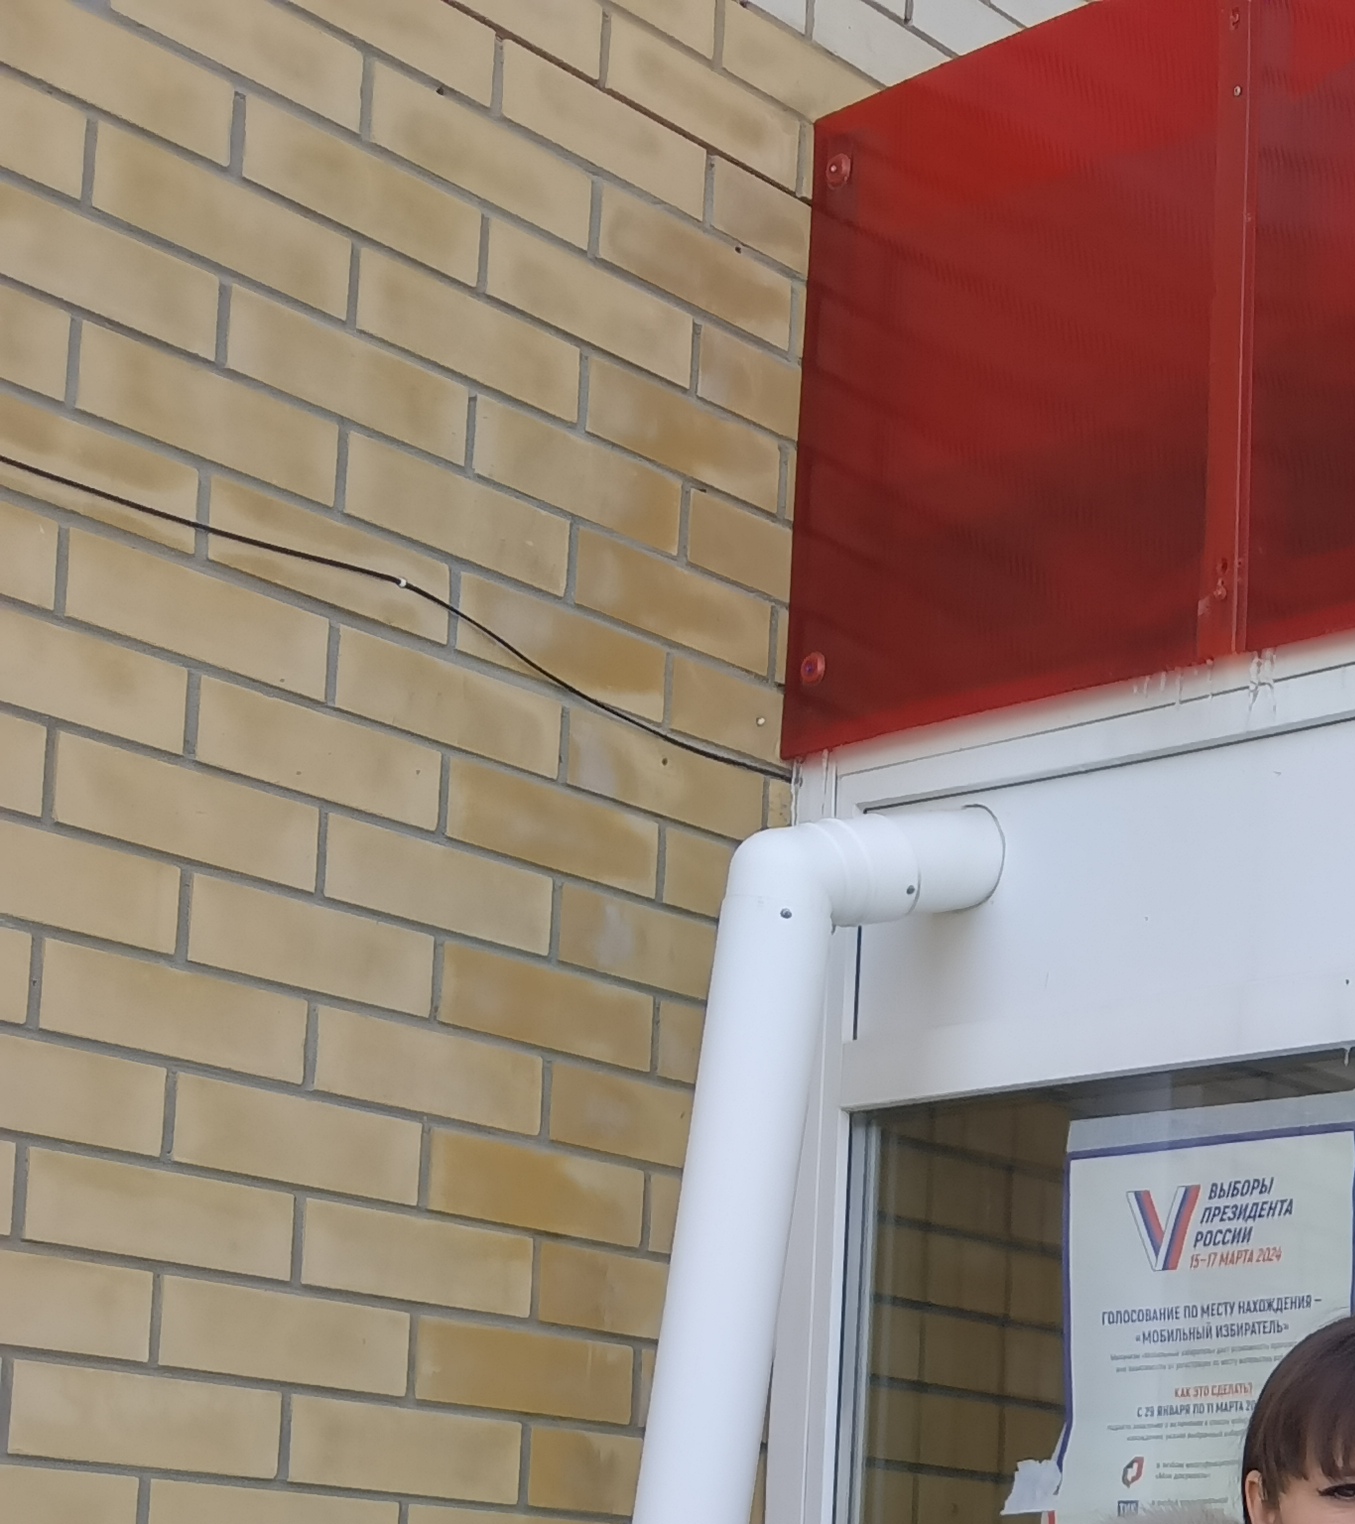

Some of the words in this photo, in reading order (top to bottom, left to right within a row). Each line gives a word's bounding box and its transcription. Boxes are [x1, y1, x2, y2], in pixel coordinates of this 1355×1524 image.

[1208, 1177, 1275, 1201] ВЫБОРЫ
[1199, 1198, 1294, 1224] ПРЕЗИДЕНТА
[1193, 1226, 1254, 1249] РОССИИ
[1218, 1248, 1254, 1266] МАРТА
[1256, 1246, 1283, 1263] 2024
[1101, 1306, 1181, 1326] ГОЛОСОВАНИЕ
[1183, 1304, 1199, 1320] ПО
[1200, 1301, 1235, 1319] МЕСТУ
[1237, 1294, 1313, 1315] НАХОЖДЕНИЯ
[1135, 1321, 1214, 1345] «МОБИЛЬНЫЙ
[1215, 1319, 1290, 1340] ИЗБИРАТЕЛЬ»
